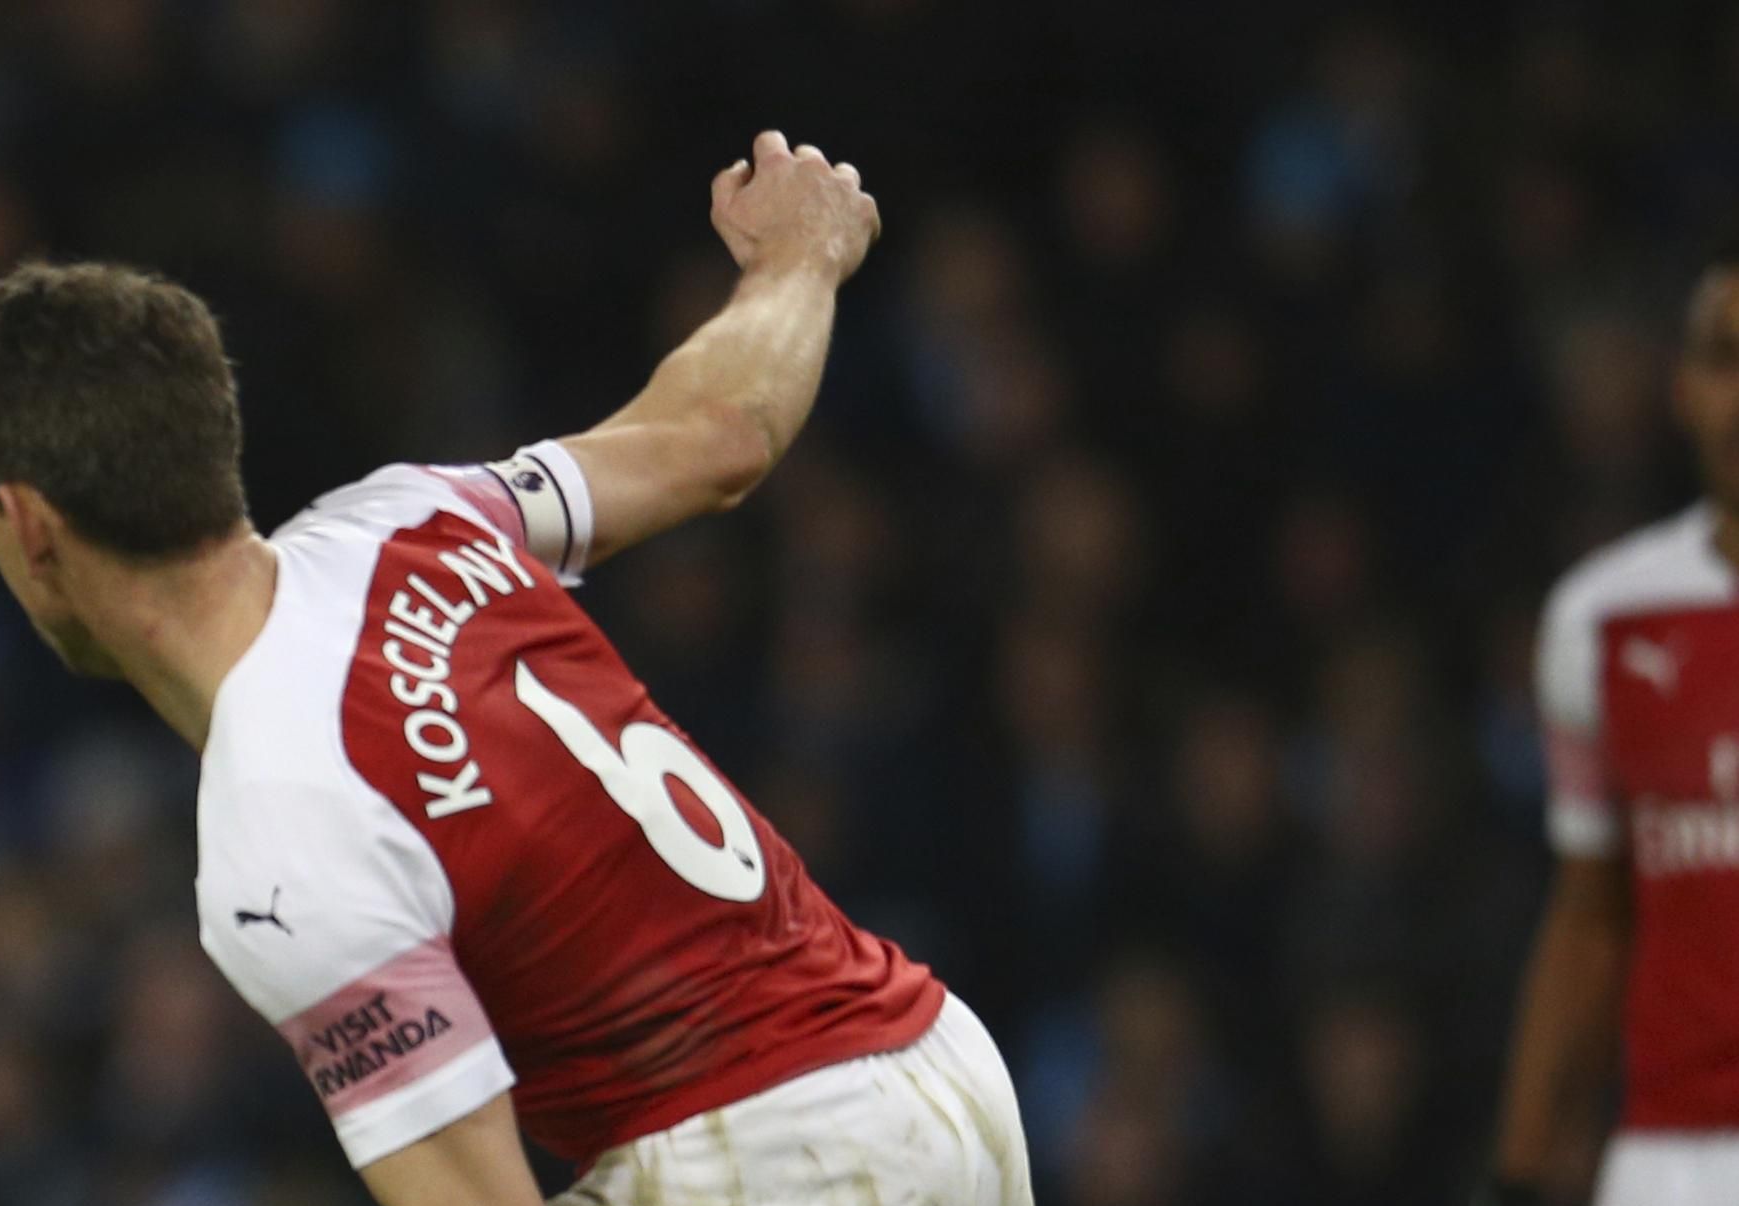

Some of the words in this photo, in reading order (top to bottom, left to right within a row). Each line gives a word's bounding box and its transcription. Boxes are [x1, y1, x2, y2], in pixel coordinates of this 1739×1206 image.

[382, 536, 535, 819] KOSCIELNY
[513, 656, 765, 903] 6
[312, 990, 393, 1053] VISIT
[315, 1006, 453, 1096] RWANDA
